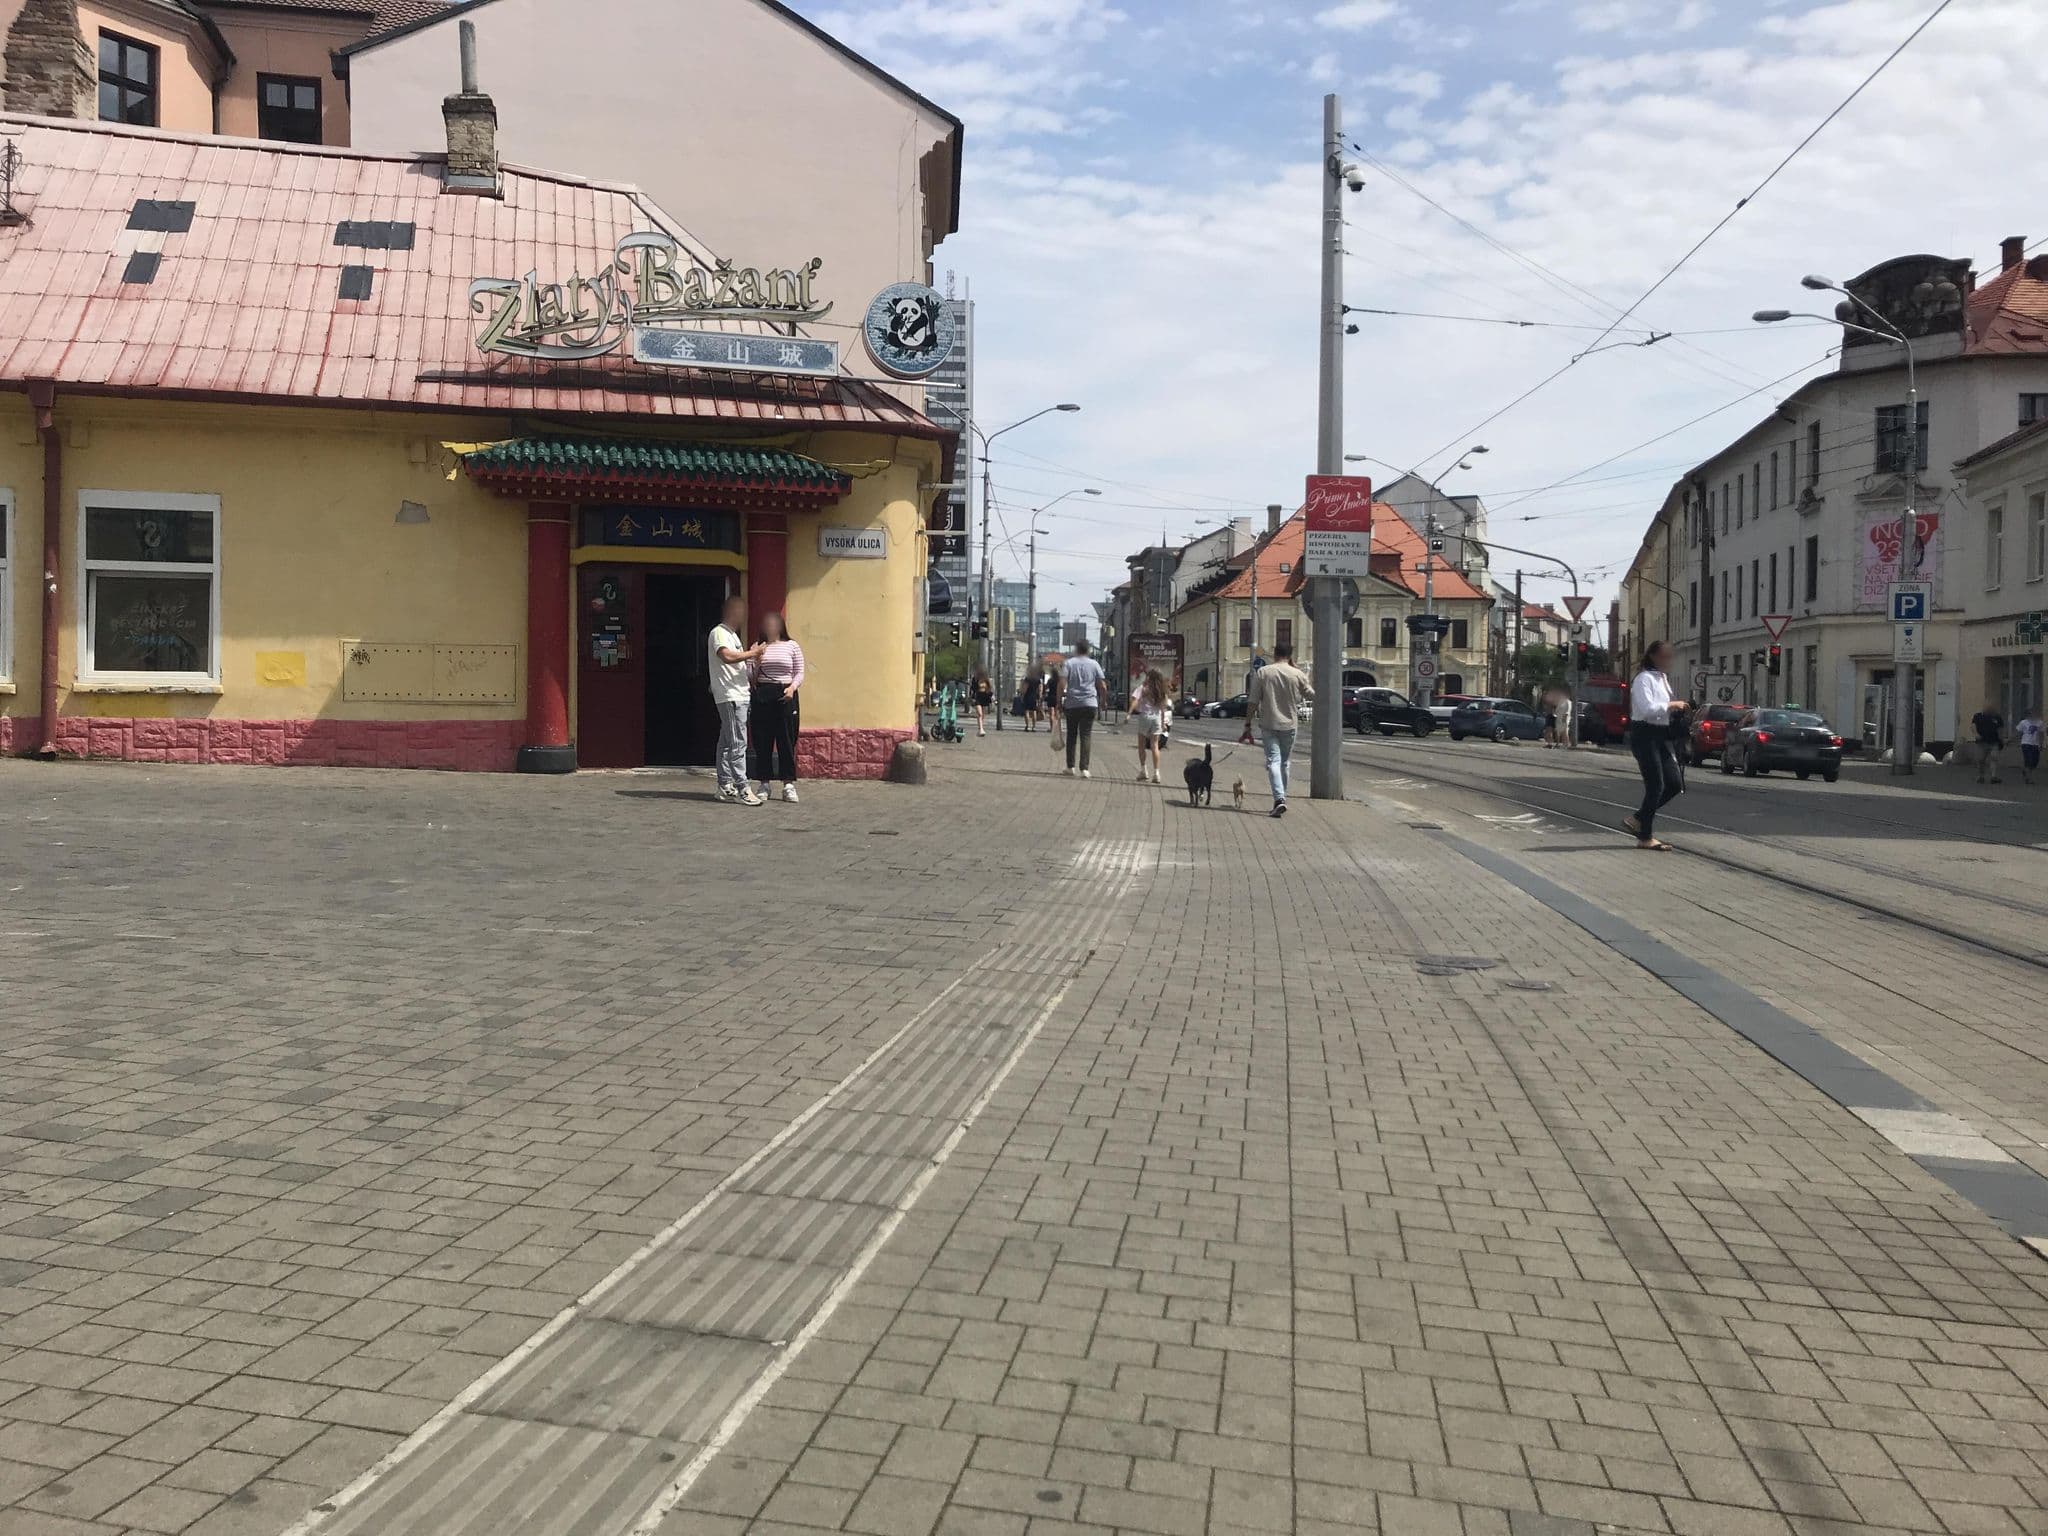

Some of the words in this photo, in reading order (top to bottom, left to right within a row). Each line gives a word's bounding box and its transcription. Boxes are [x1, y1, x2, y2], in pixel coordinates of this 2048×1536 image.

[469, 264, 628, 359] Zlatý
[615, 232, 824, 314] Bažant
[671, 336, 804, 366] 金山城
[616, 513, 705, 544] 金山城
[825, 535, 856, 549] VYSOKÁ
[857, 537, 881, 550] ULICA
[1901, 596, 1918, 616] P
